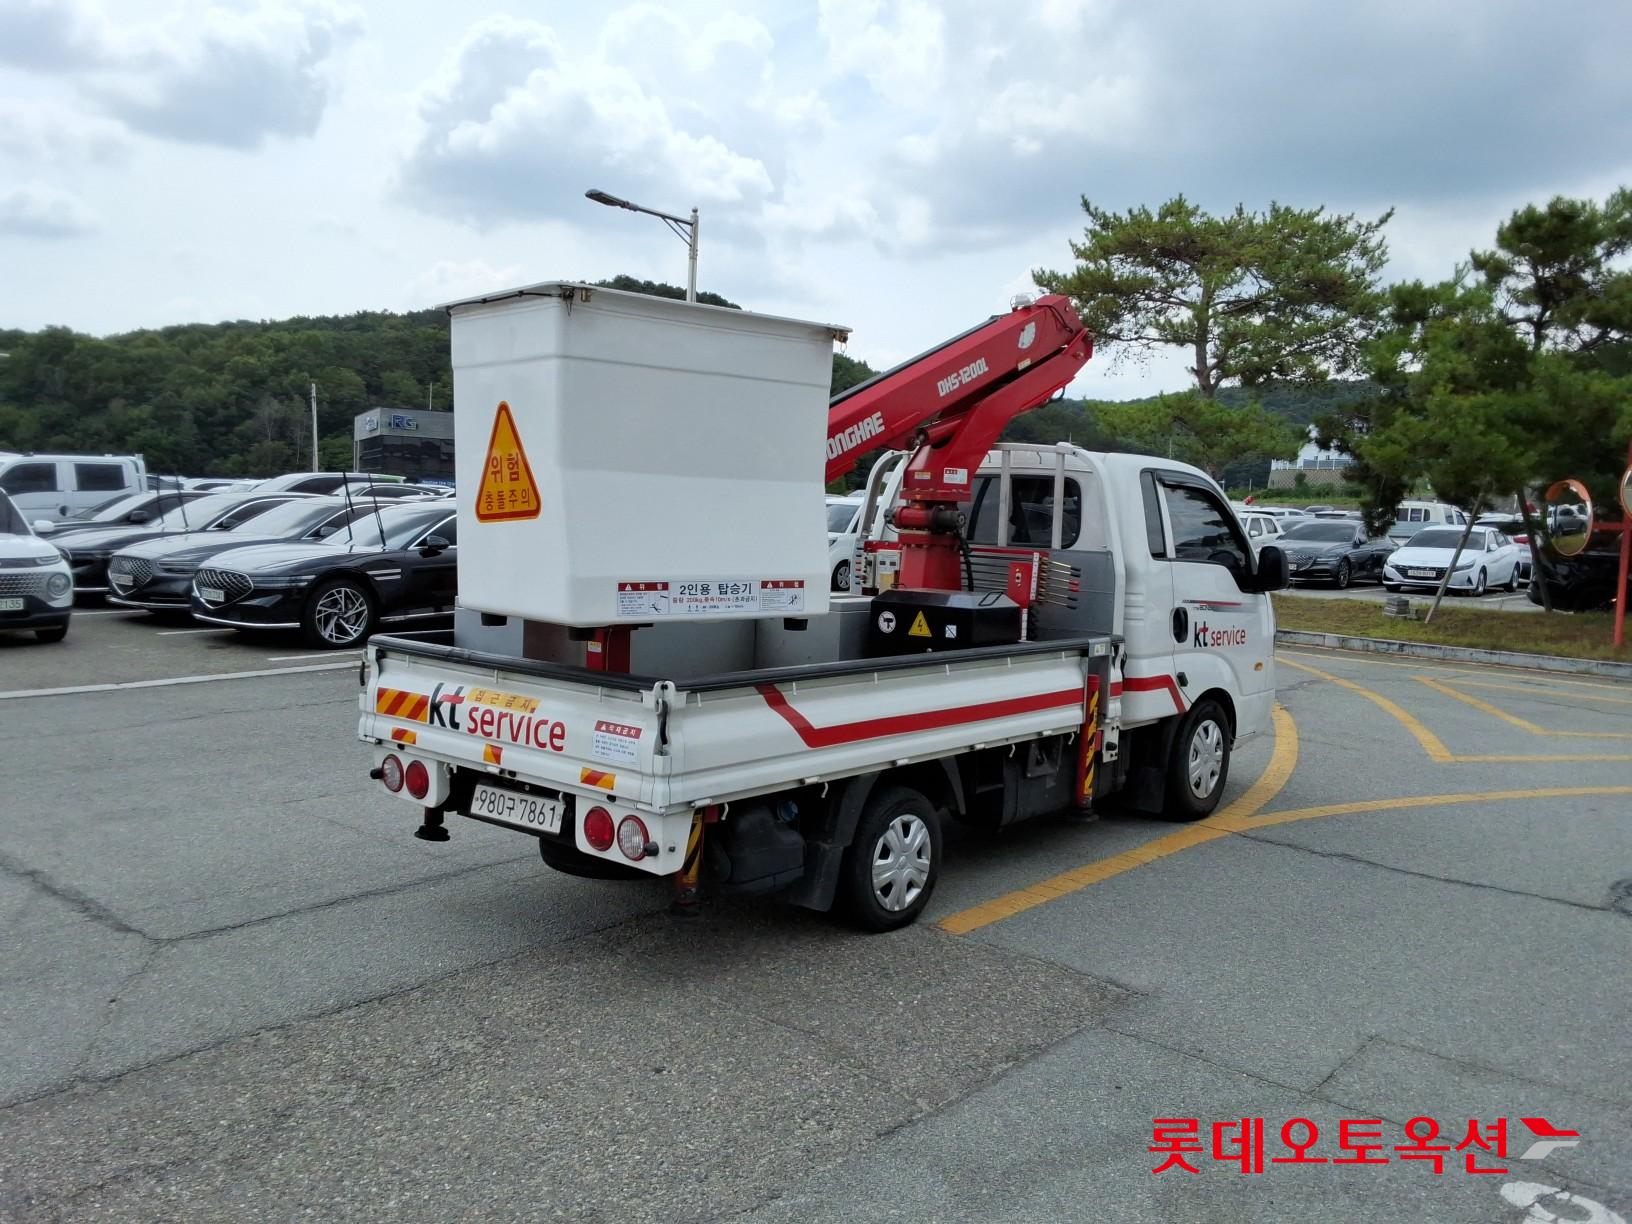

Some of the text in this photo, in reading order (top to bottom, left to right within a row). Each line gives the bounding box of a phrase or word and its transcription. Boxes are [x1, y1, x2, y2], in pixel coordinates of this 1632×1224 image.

[826, 411, 885, 460] ONGHAE
[491, 452, 520, 483] 위험
[485, 487, 530, 511] 충돌주의
[680, 582, 752, 595] 2인용 탑승기
[1194, 621, 1246, 648] kt service
[429, 682, 465, 731] kt
[467, 705, 566, 752] service
[478, 789, 556, 828] 980구7861
